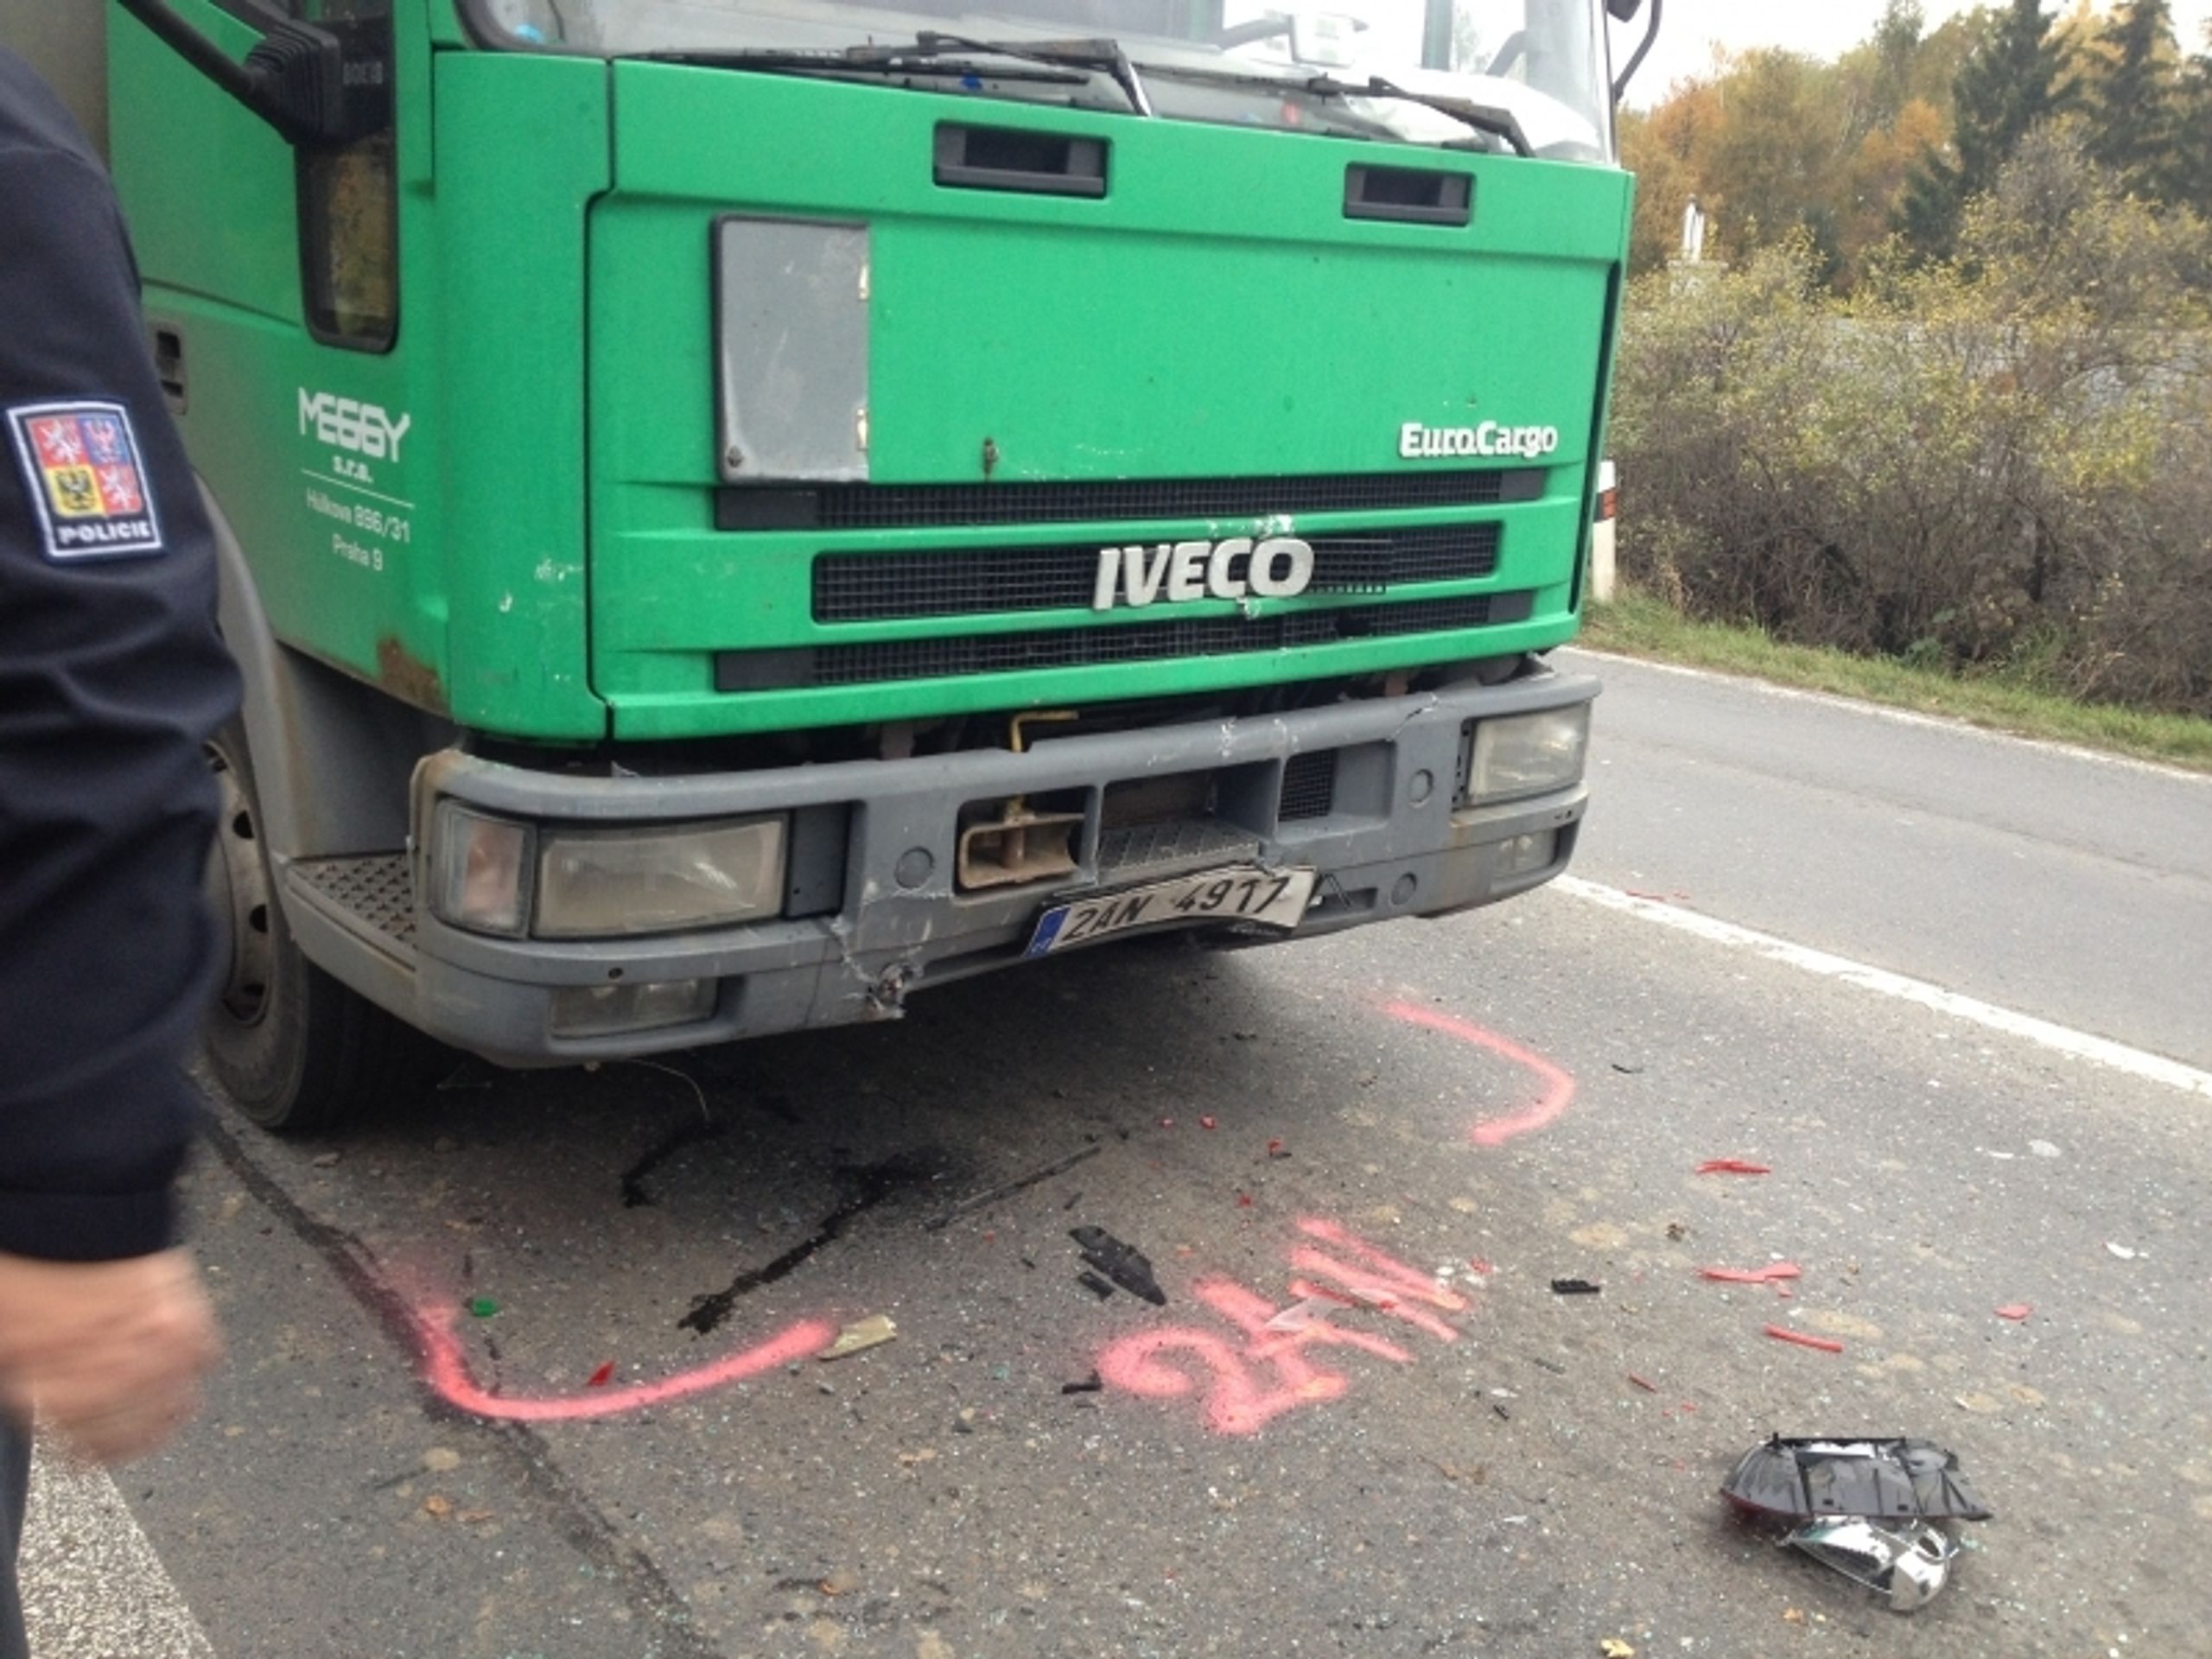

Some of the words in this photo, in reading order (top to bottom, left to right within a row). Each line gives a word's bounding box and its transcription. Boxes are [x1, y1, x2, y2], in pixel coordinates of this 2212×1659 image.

[1398, 421, 1558, 458] EuroCargo
[56, 520, 151, 545] POLICIE
[1092, 537, 1315, 611] IVECO
[1060, 893, 1154, 942] 2AN
[1173, 875, 1290, 914] 4917
